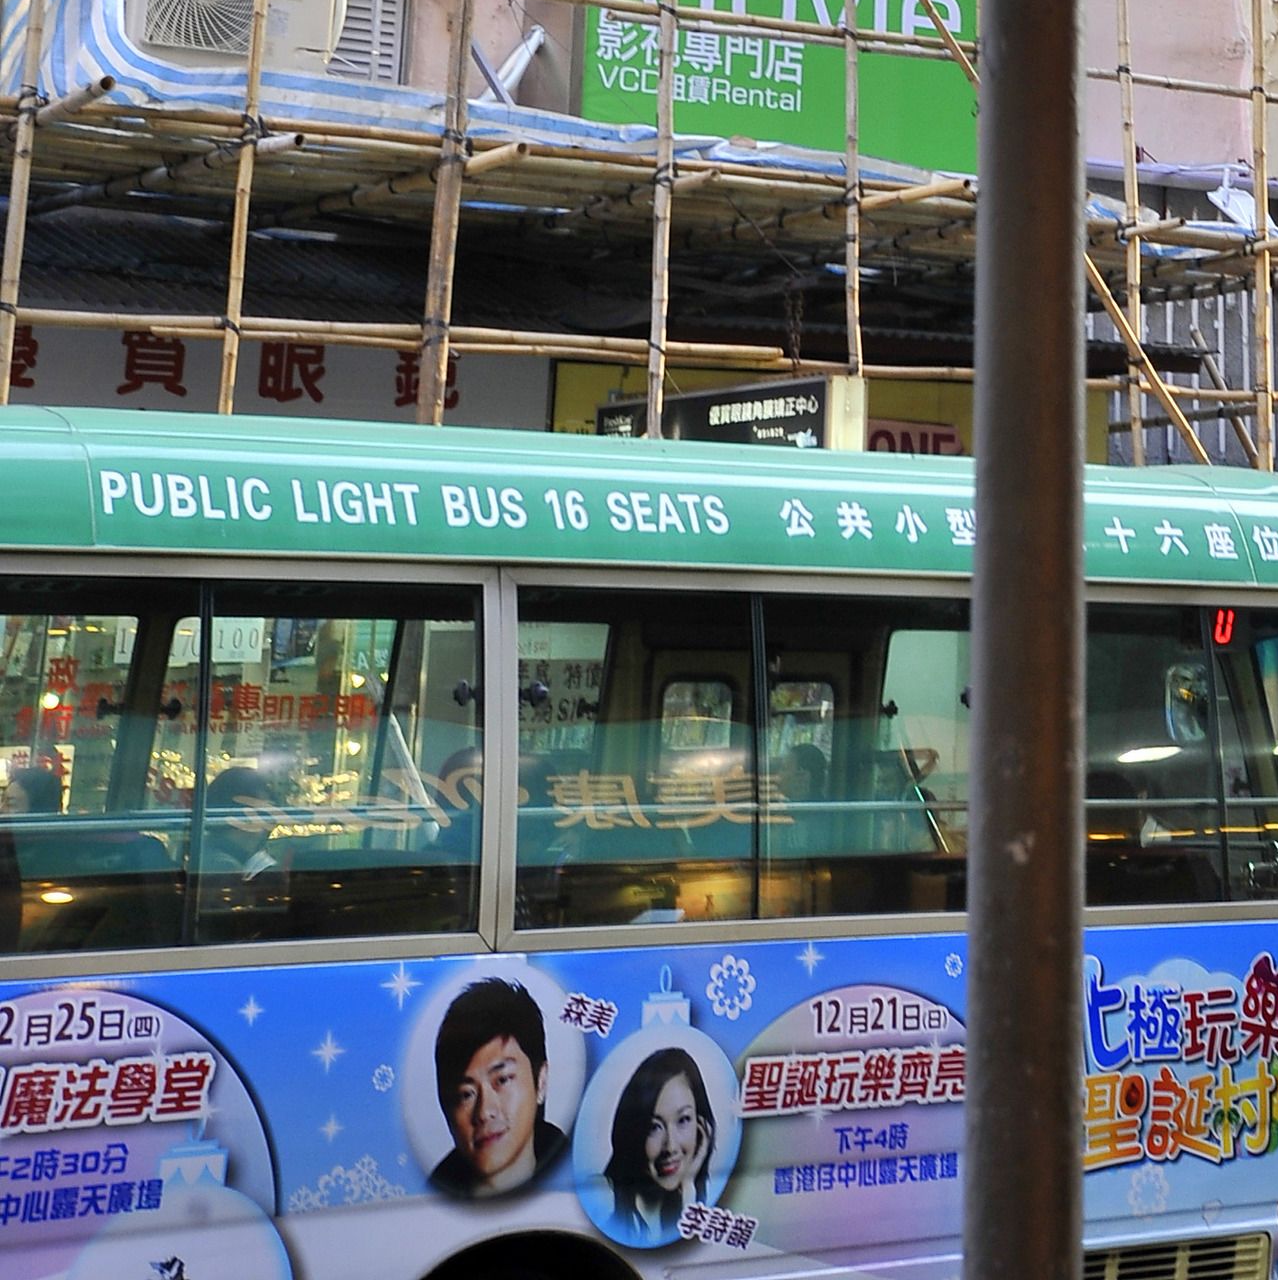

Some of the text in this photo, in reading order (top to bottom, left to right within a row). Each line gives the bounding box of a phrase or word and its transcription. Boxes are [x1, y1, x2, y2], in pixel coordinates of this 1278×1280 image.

[100, 470, 731, 536] PUBLIC LIGHT BUS 16 SEATS
[560, 994, 617, 1034] 森美
[0, 1057, 211, 1129] 魔法學堂
[1083, 1061, 1275, 1166] 聖誕村
[834, 1122, 910, 1155] 下午4時
